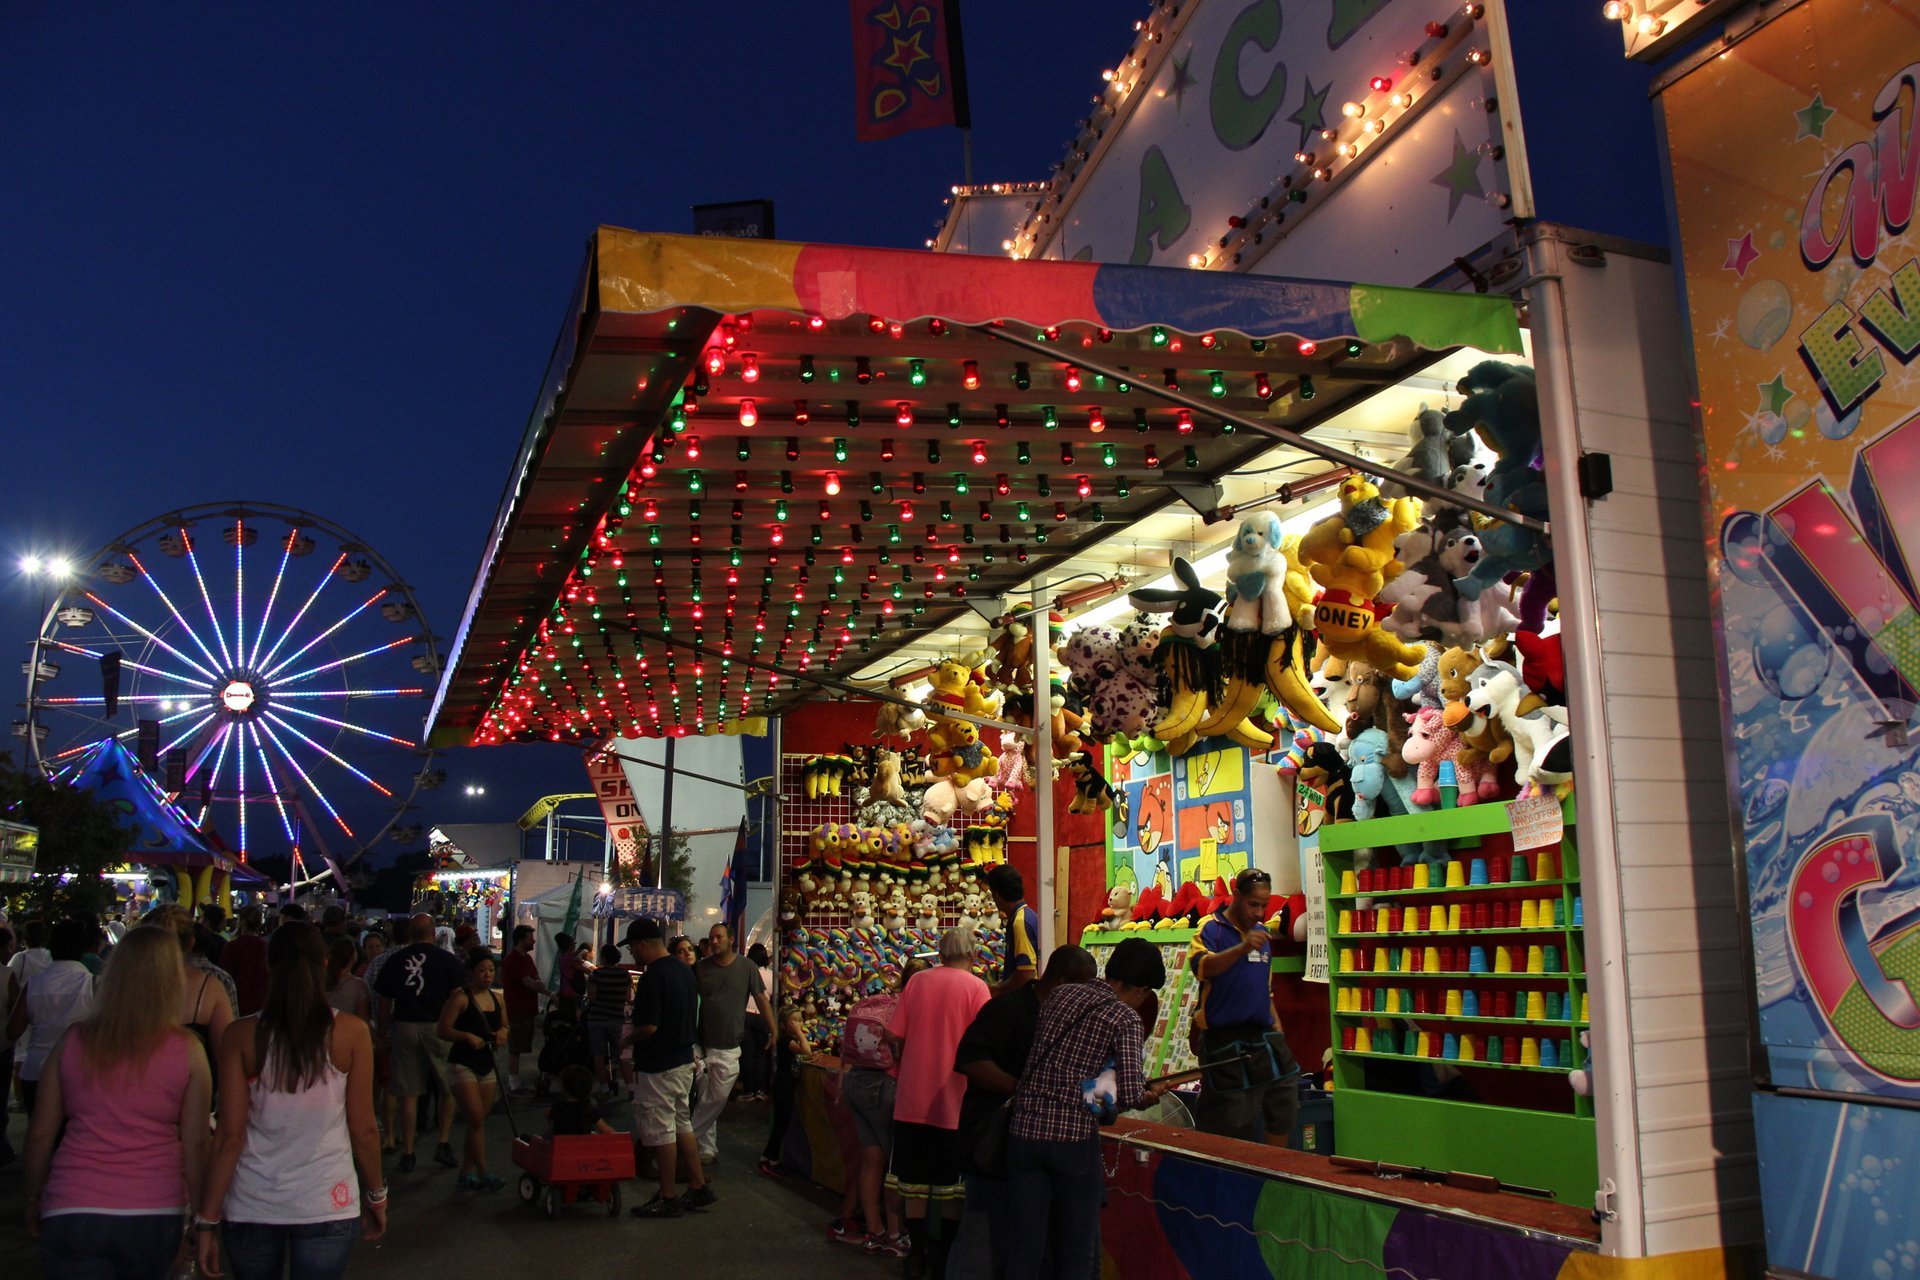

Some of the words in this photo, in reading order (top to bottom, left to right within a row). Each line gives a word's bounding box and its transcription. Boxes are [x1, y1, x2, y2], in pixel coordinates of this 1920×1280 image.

[1315, 606, 1371, 630] ONEY
[624, 893, 676, 913] ENTER
[1310, 944, 1322, 958] KIDS
